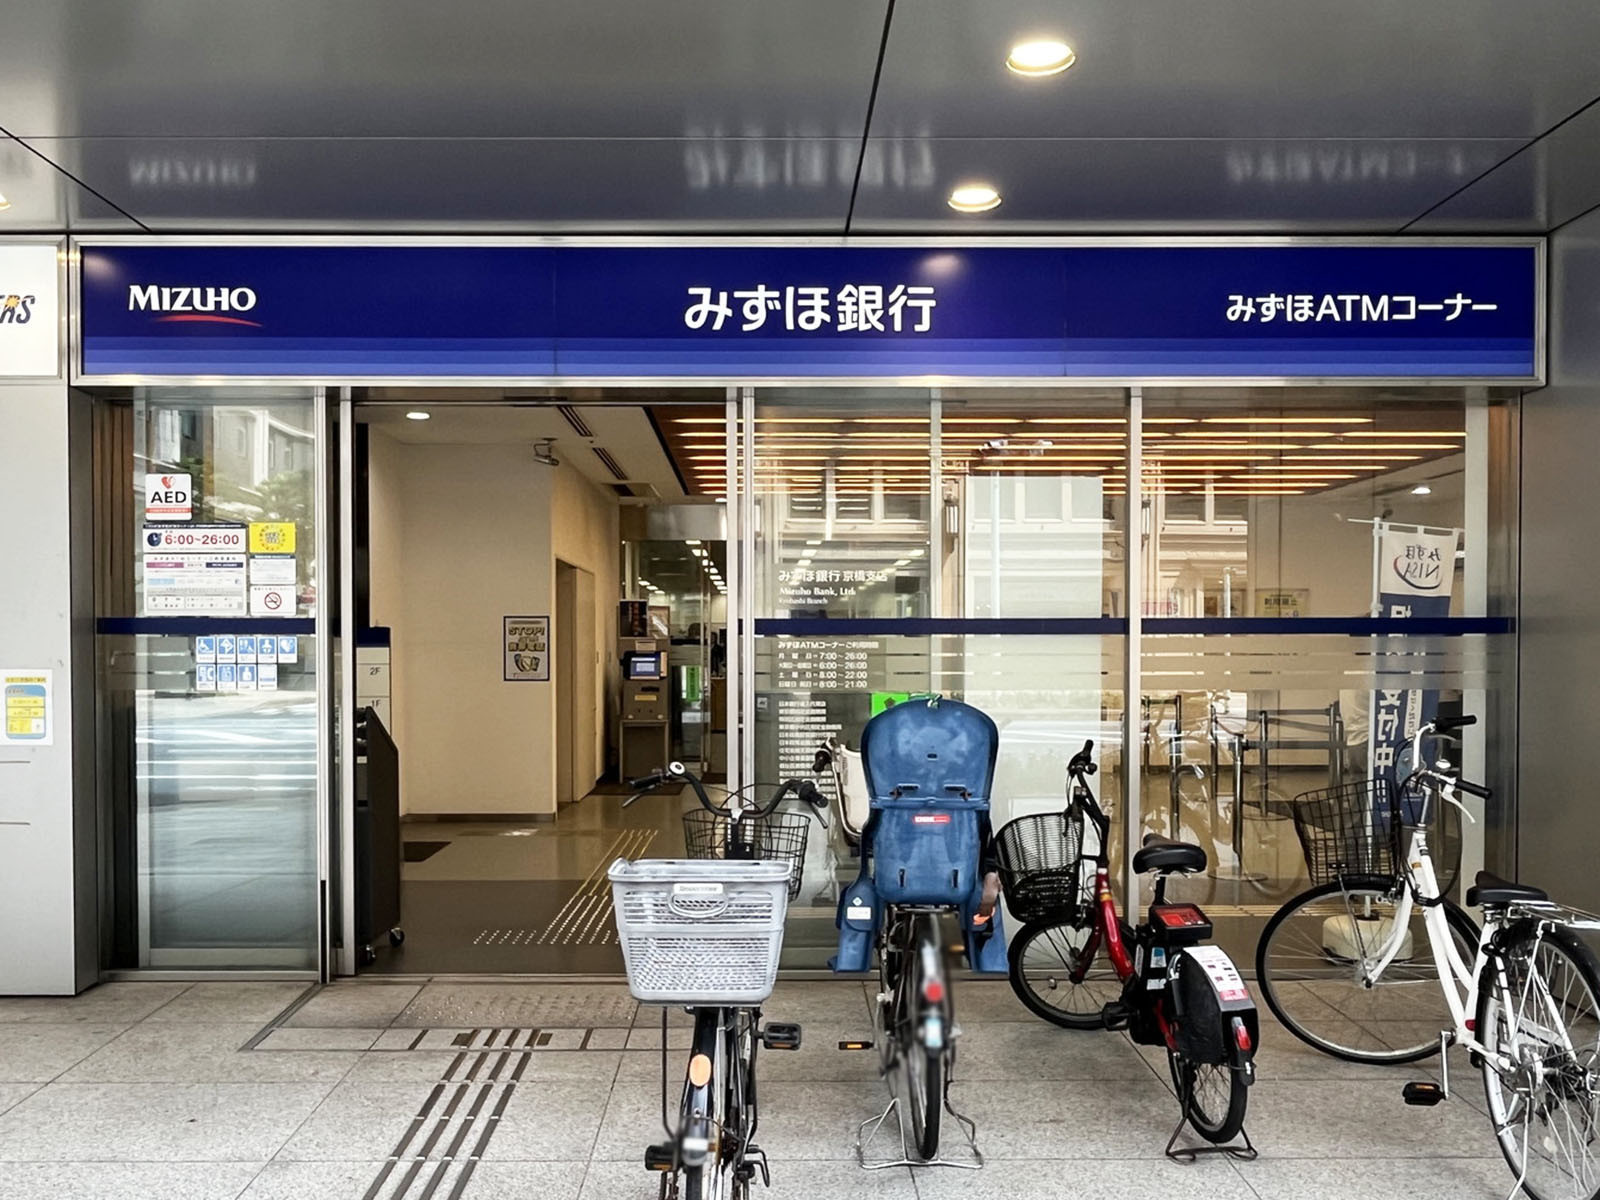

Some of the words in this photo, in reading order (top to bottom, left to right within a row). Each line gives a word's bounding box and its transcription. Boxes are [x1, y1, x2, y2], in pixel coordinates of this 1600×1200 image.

[128, 284, 257, 312] MIZUHO
[684, 284, 936, 332] みずほ銀行
[1226, 292, 1498, 323] みずほATMコーナー
[150, 491, 187, 504] AED
